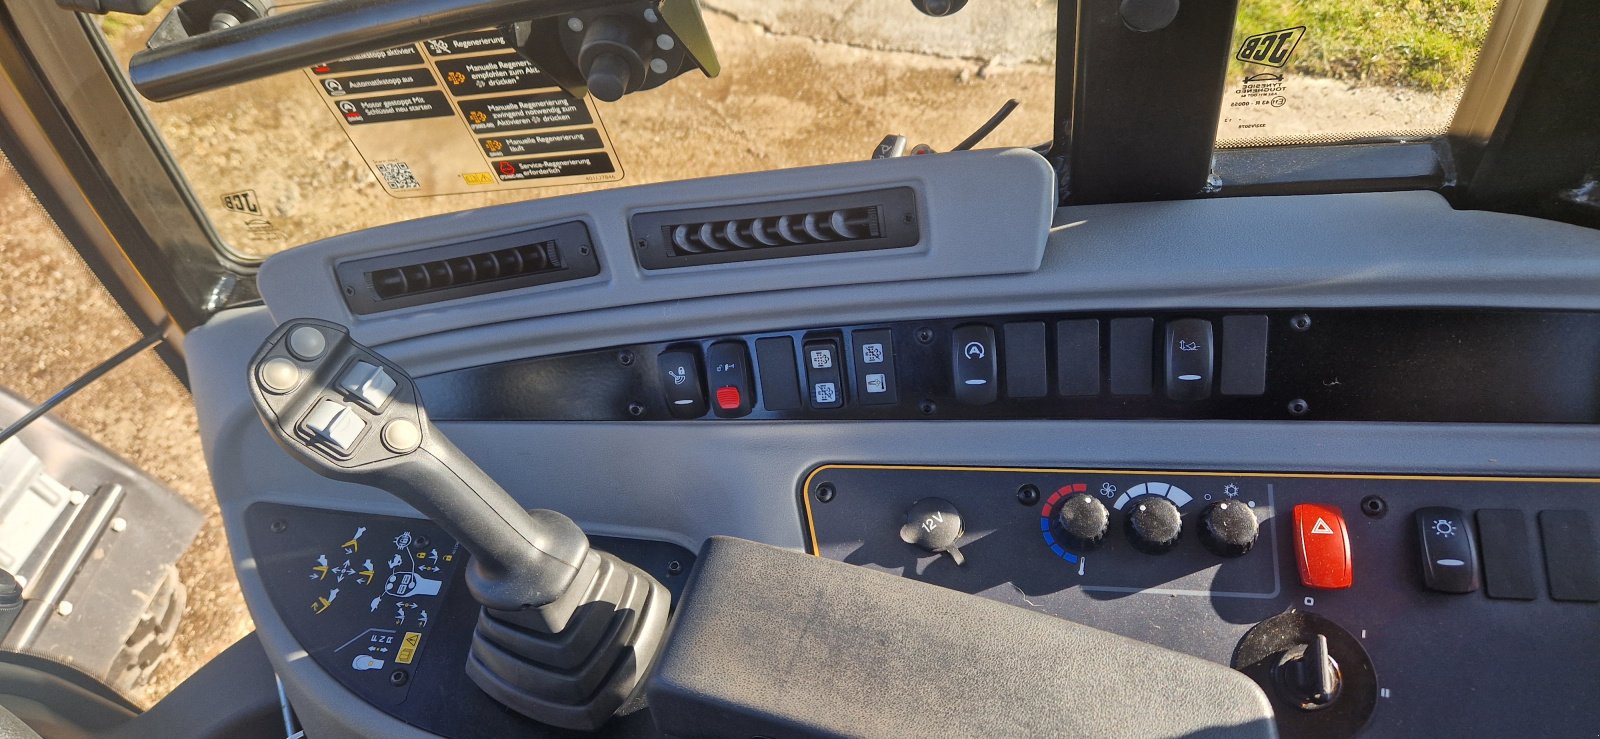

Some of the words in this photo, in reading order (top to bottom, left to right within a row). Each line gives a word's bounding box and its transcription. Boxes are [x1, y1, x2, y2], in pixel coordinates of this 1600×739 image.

[453, 37, 505, 48] Regenerierung
[386, 47, 415, 57] aktiviert
[466, 64, 498, 72] Manuelle
[471, 71, 508, 80] empfohlen
[349, 78, 401, 88] Automatikstopp
[383, 98, 413, 108] gestoppt
[409, 103, 432, 111] starten
[487, 102, 518, 111] Manuelle
[518, 98, 569, 109] Regenerierung
[492, 110, 525, 119] zwingend
[525, 106, 561, 115] notwendig
[543, 114, 571, 122] drücken
[506, 137, 536, 146] Manuelle
[536, 133, 584, 144] Regenerierung
[519, 158, 591, 170] Service-Regenerierung
[921, 510, 944, 533] 12V
